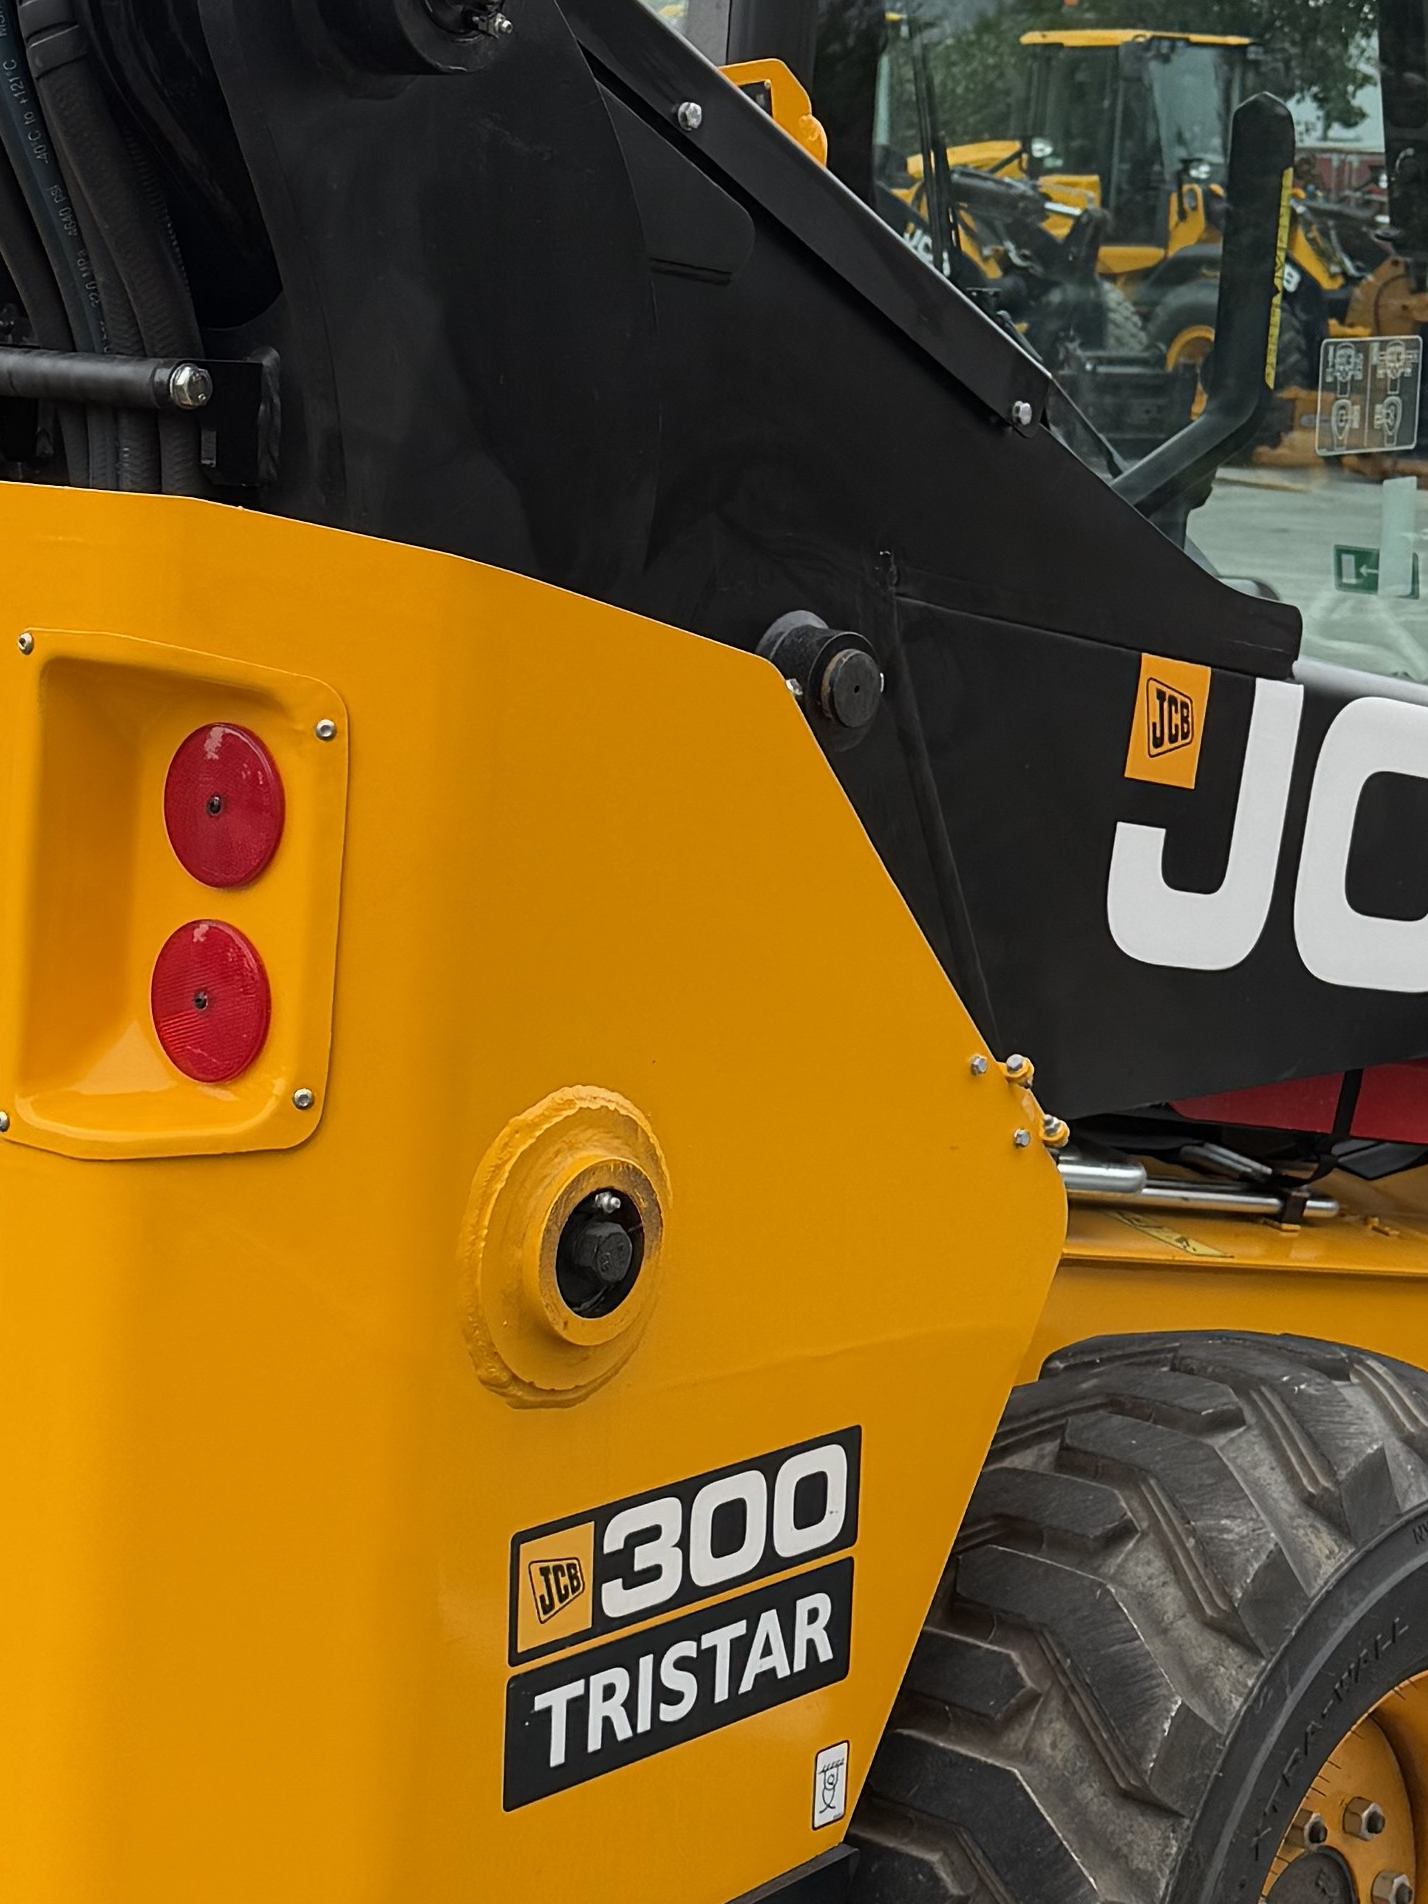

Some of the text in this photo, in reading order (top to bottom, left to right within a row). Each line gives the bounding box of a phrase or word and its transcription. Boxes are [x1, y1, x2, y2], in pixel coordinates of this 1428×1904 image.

[1152, 688, 1194, 750] JCB
[538, 1561, 582, 1617] JCB
[601, 1444, 848, 1619] 300
[533, 1592, 834, 1768] TRISTAR
